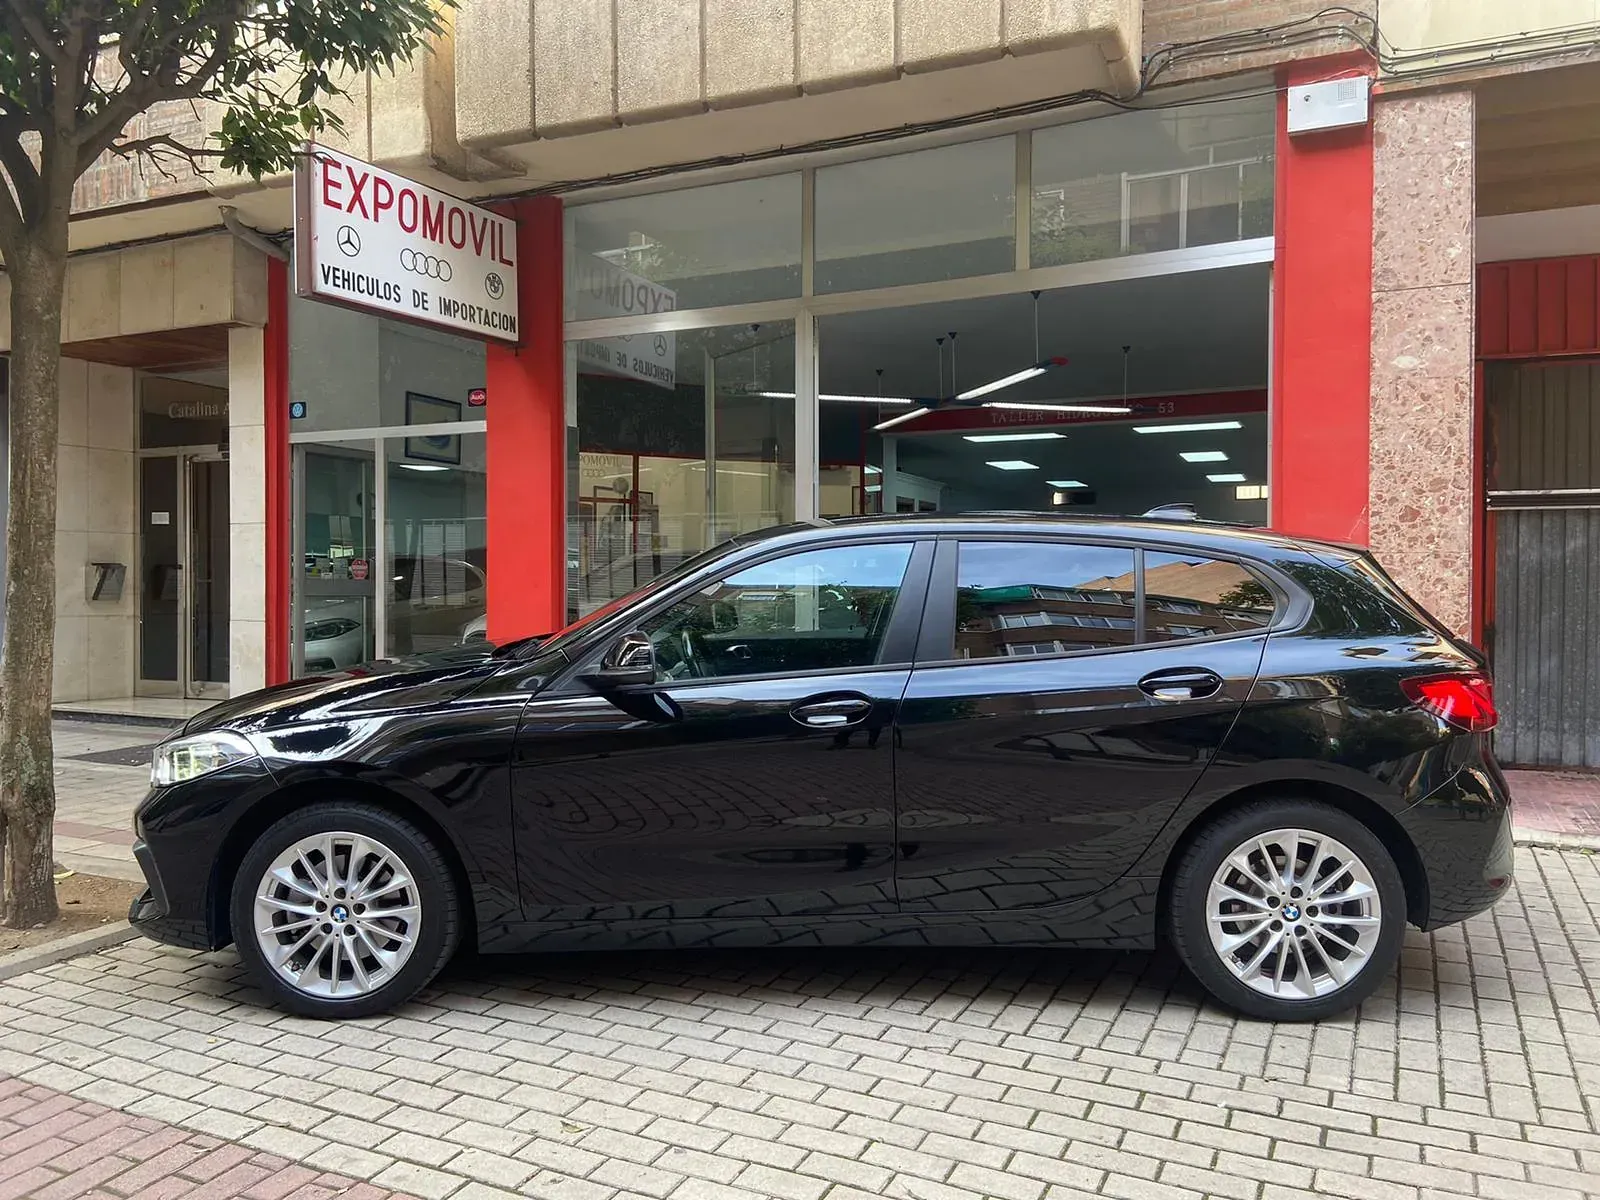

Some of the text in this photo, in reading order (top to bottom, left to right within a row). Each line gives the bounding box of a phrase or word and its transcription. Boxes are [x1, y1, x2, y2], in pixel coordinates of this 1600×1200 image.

[321, 156, 514, 267] EXPOMOVIL
[320, 263, 517, 334] VEHICULOS DE IMPORTACION
[168, 401, 219, 419] Catalina
[990, 410, 1044, 424] TALLER
[1157, 402, 1175, 414] 53
